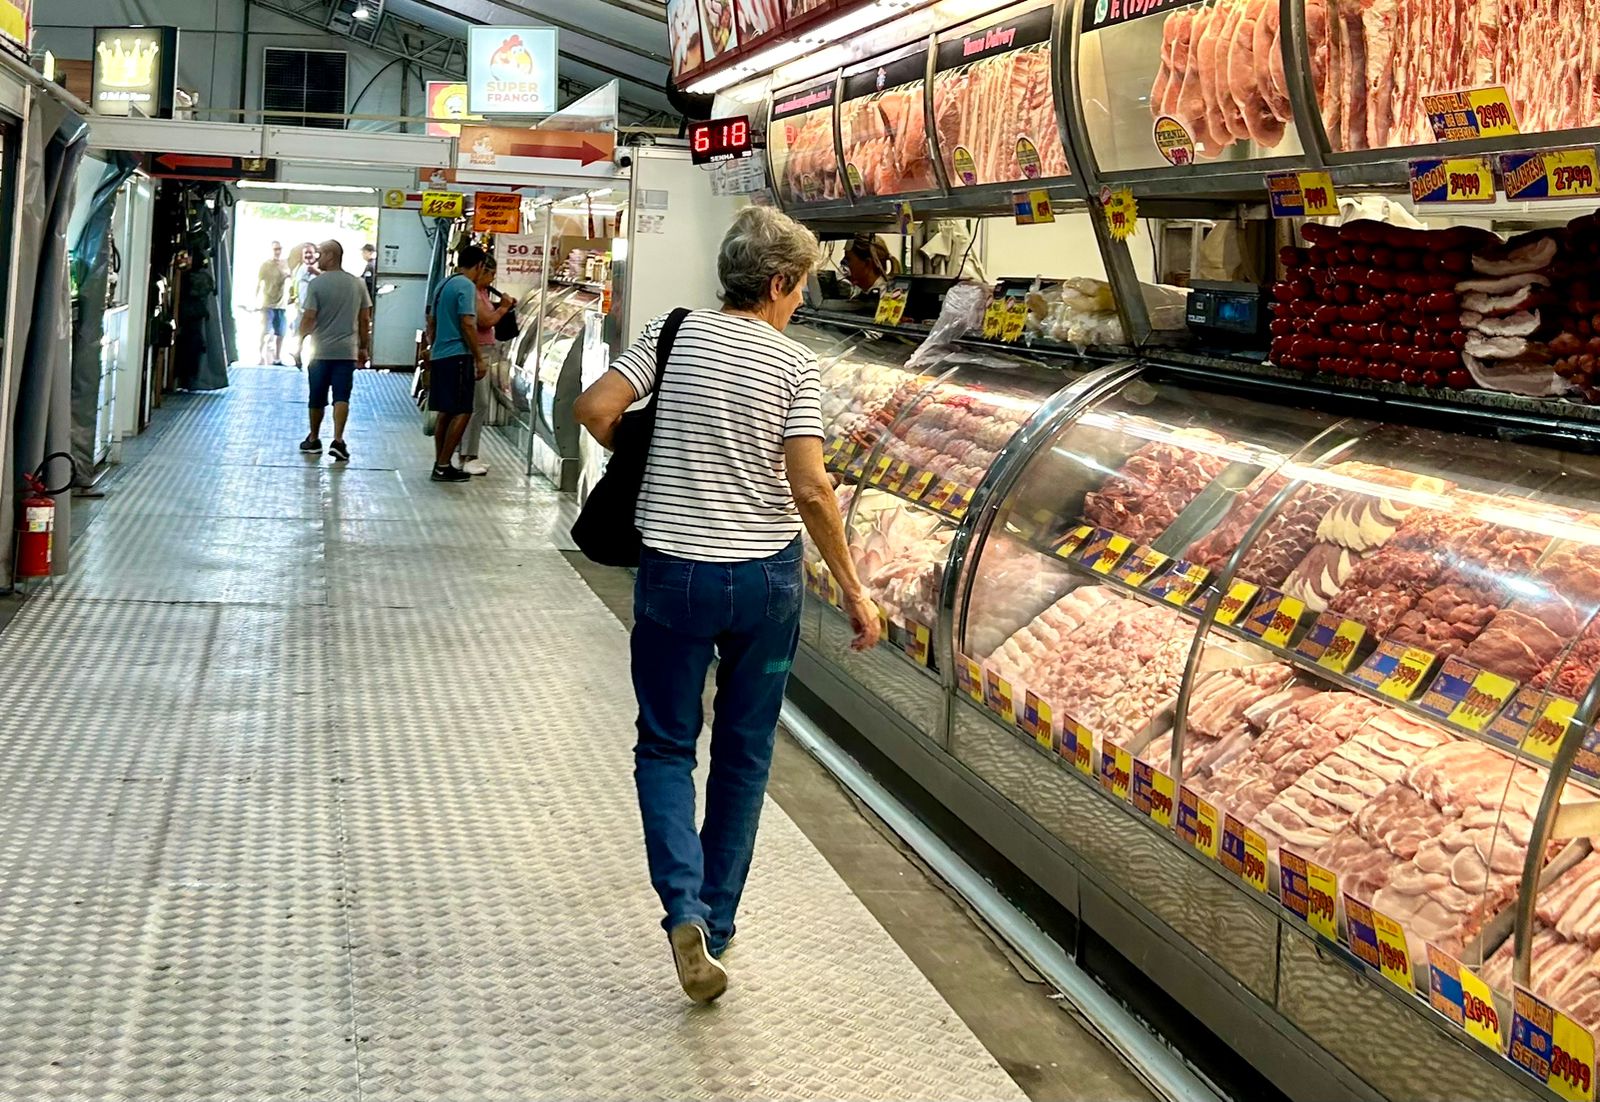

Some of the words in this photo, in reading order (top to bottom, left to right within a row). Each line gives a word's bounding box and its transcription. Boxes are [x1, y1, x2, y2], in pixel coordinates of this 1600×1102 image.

[985, 27, 1016, 50] Delivery
[487, 81, 538, 92] SUPER
[487, 94, 539, 103] FRANGO
[1423, 91, 1472, 115] COSTELA
[1156, 128, 1186, 141] PERNIL
[1445, 127, 1480, 141] ESPECIAL
[711, 153, 735, 162] SENHA
[1411, 164, 1447, 200] BACON
[507, 244, 528, 255] 50
[1444, 660, 1479, 684] BIFE
